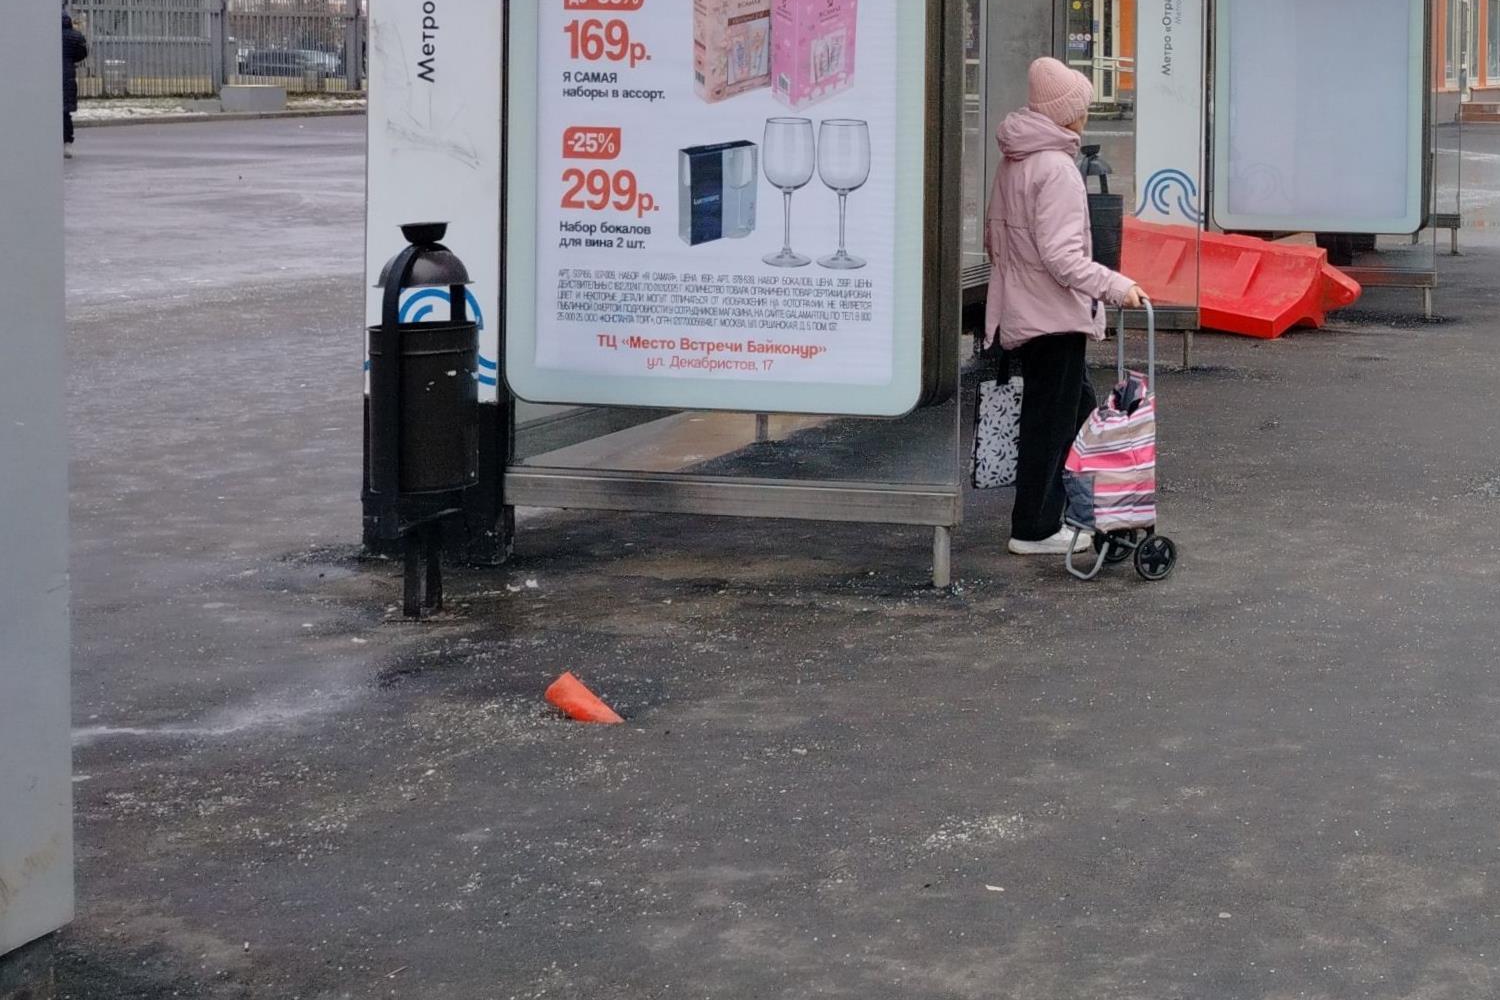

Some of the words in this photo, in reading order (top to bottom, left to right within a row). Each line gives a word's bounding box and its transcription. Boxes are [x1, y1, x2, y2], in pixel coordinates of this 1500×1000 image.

[417, 0, 439, 83] Метро
[563, 18, 651, 68] 169р.
[1161, 35, 1173, 76] Метро
[563, 71, 571, 82] Я
[574, 72, 618, 83] САМАЯ
[563, 86, 608, 100] наборы
[611, 89, 619, 97] в
[622, 90, 666, 102] ассорт.
[568, 132, 615, 153] -25%
[560, 168, 659, 219] 299р.
[559, 221, 597, 235] Набор
[600, 222, 651, 235] бокалов
[559, 238, 582, 249] для
[585, 238, 613, 248] вина
[617, 238, 623, 248] 2
[627, 239, 645, 249] шт.
[597, 334, 617, 349] ТЦ
[621, 336, 676, 350] «Место
[680, 337, 743, 353] Встречи
[747, 338, 827, 358] Байконур»
[647, 358, 663, 369] ул.
[670, 355, 758, 371] Декабристов,
[763, 359, 773, 370] 17
